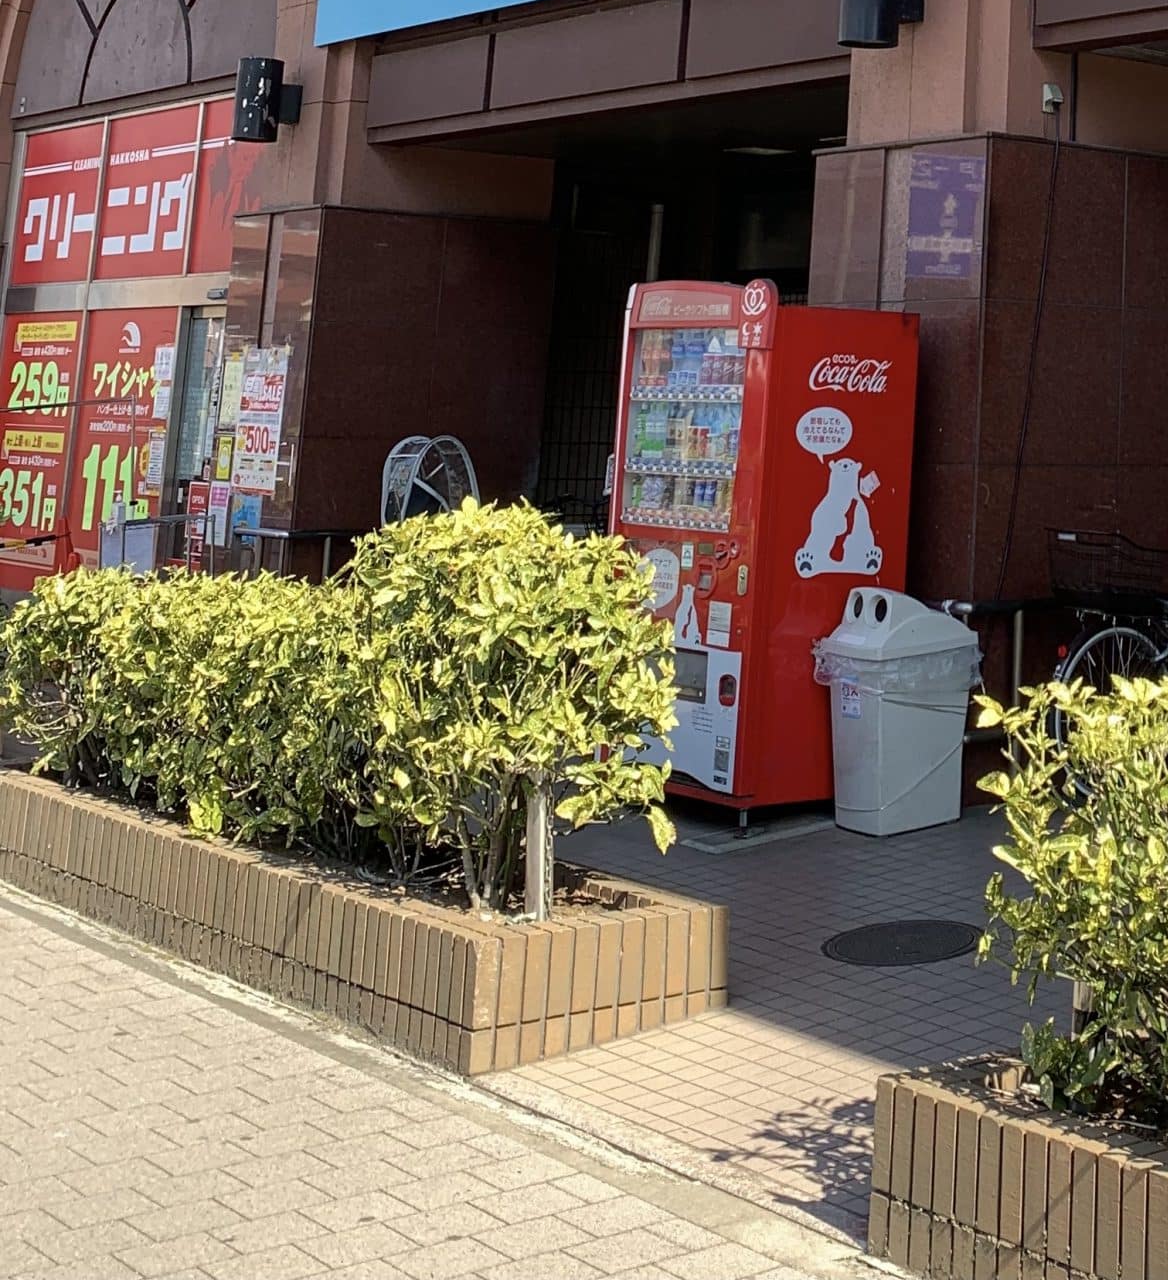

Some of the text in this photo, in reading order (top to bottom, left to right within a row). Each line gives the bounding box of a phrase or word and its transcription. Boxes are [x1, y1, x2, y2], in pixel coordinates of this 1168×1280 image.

[110, 148, 150, 166] HAKKOSHA
[23, 172, 194, 263] クリーニング
[808, 357, 893, 393] Coca-Cola
